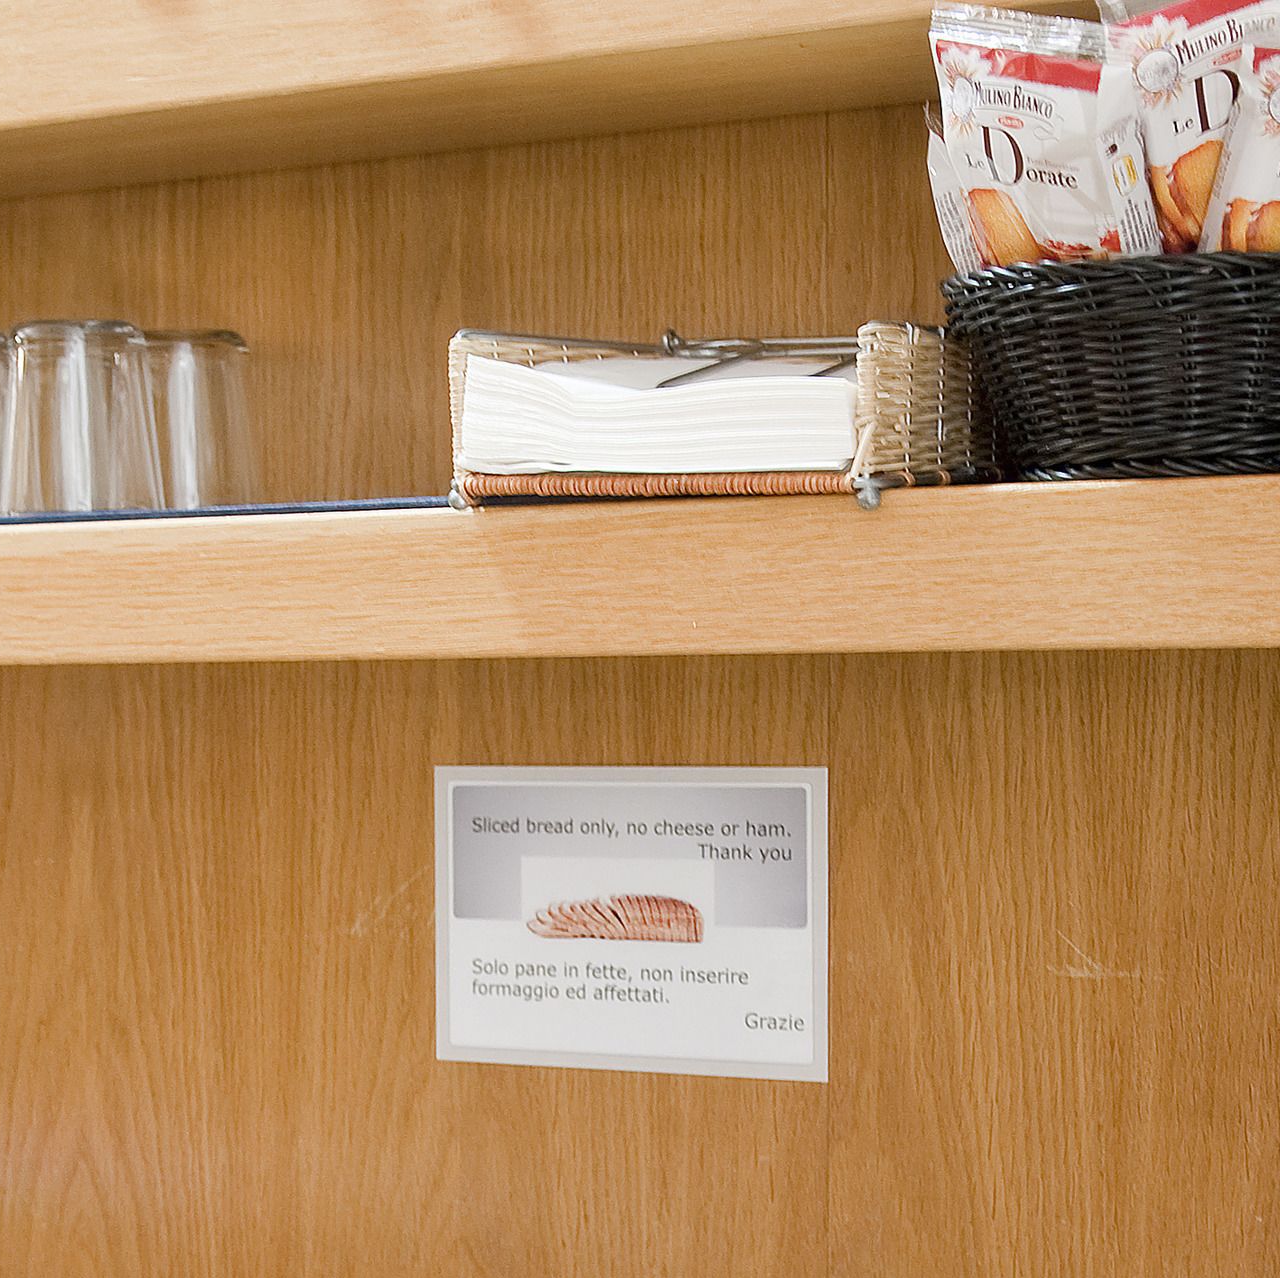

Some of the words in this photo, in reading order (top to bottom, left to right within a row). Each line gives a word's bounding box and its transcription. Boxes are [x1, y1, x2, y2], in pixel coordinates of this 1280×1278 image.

[1173, 117, 1194, 136] Le
[964, 152, 985, 169] Le
[981, 125, 1078, 190] Dorate
[472, 816, 520, 834] Sliced
[526, 817, 574, 835] bread
[580, 818, 619, 838] only,
[626, 821, 648, 836] no
[654, 818, 714, 836] cheese
[720, 822, 740, 837] or
[745, 819, 792, 838] ham.
[698, 843, 753, 860] Thank
[759, 846, 792, 864] you
[472, 958, 509, 976] Solo
[515, 962, 557, 979] pane
[563, 961, 579, 978] in
[585, 962, 632, 983] fette,
[640, 966, 673, 982] non
[680, 965, 749, 986] inserire
[472, 979, 560, 1001] formaggio
[565, 983, 586, 1000] ed
[593, 984, 670, 1004] affettati.
[744, 1012, 805, 1032] Grazie
